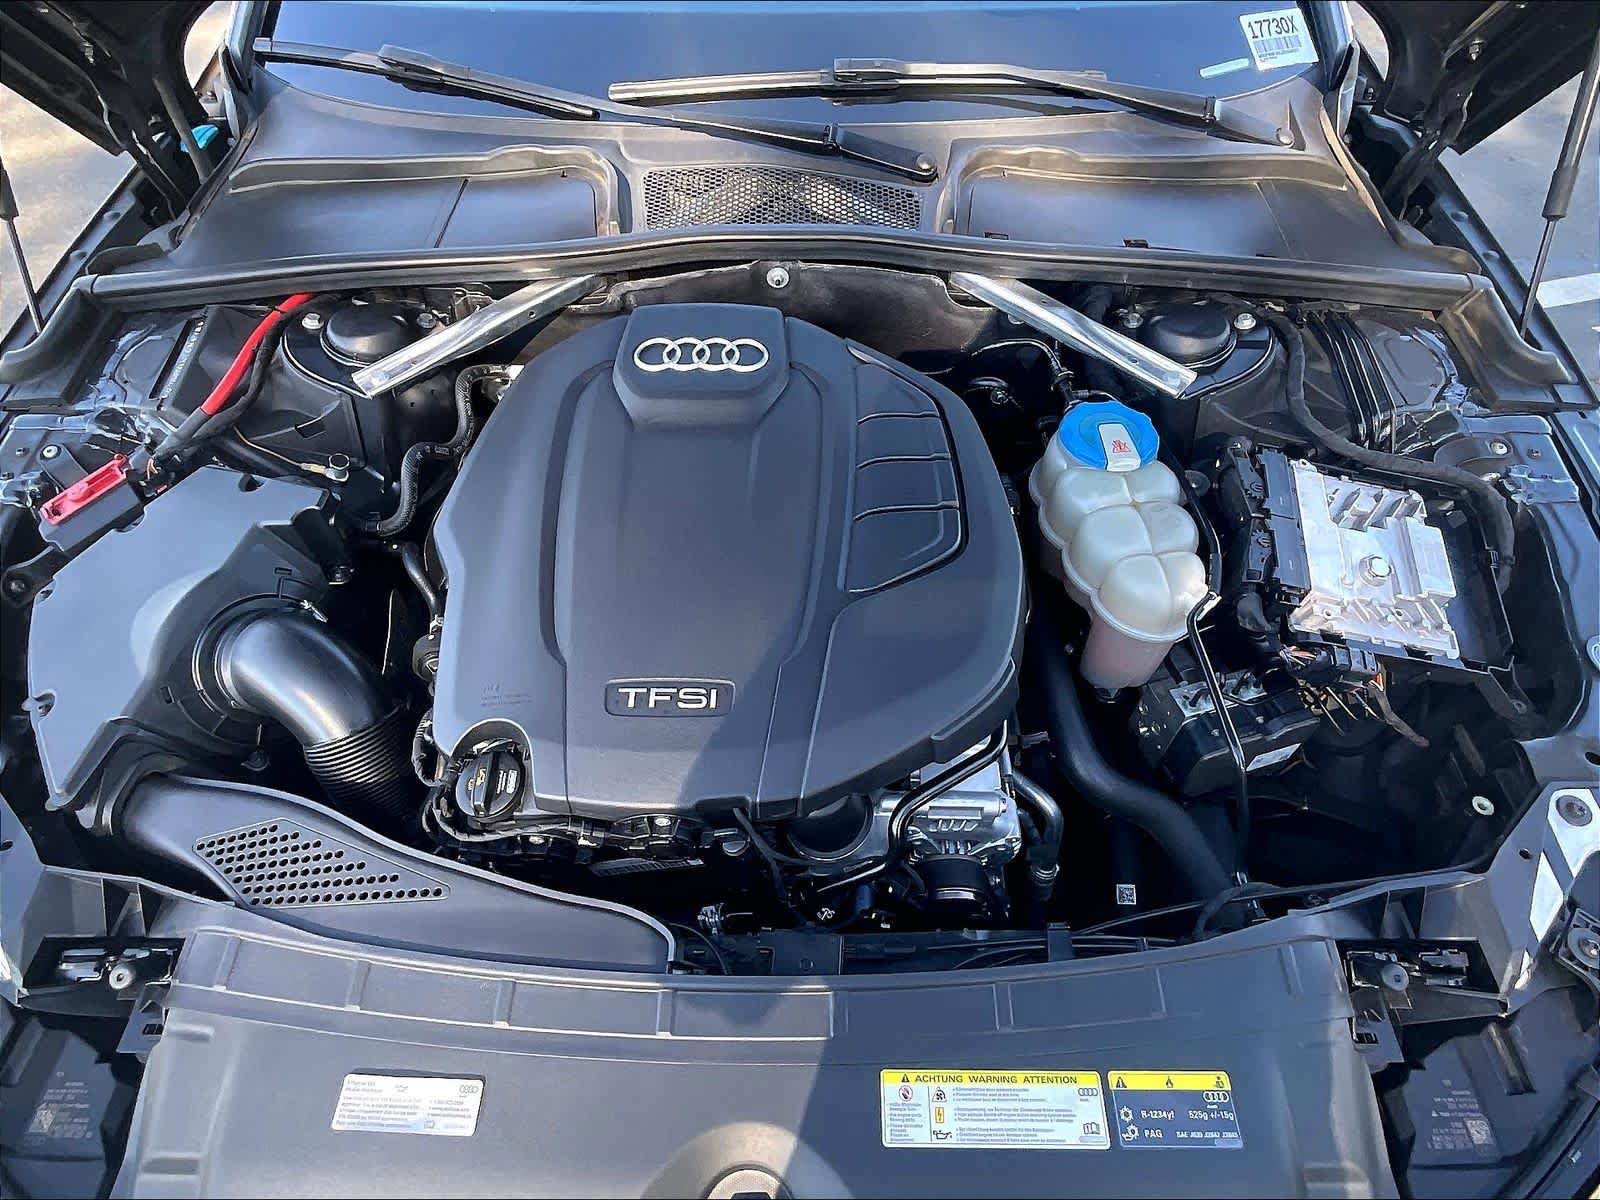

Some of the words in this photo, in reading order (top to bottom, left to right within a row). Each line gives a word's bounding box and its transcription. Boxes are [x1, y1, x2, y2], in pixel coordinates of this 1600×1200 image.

[1248, 16, 1298, 39] 17730X
[618, 687, 718, 709] TFSI
[915, 1075, 963, 1083] ACHTUNG
[968, 1075, 1018, 1084] WARNING
[1023, 1076, 1077, 1084] ATTENTION
[1144, 1129, 1163, 1138] PAG
